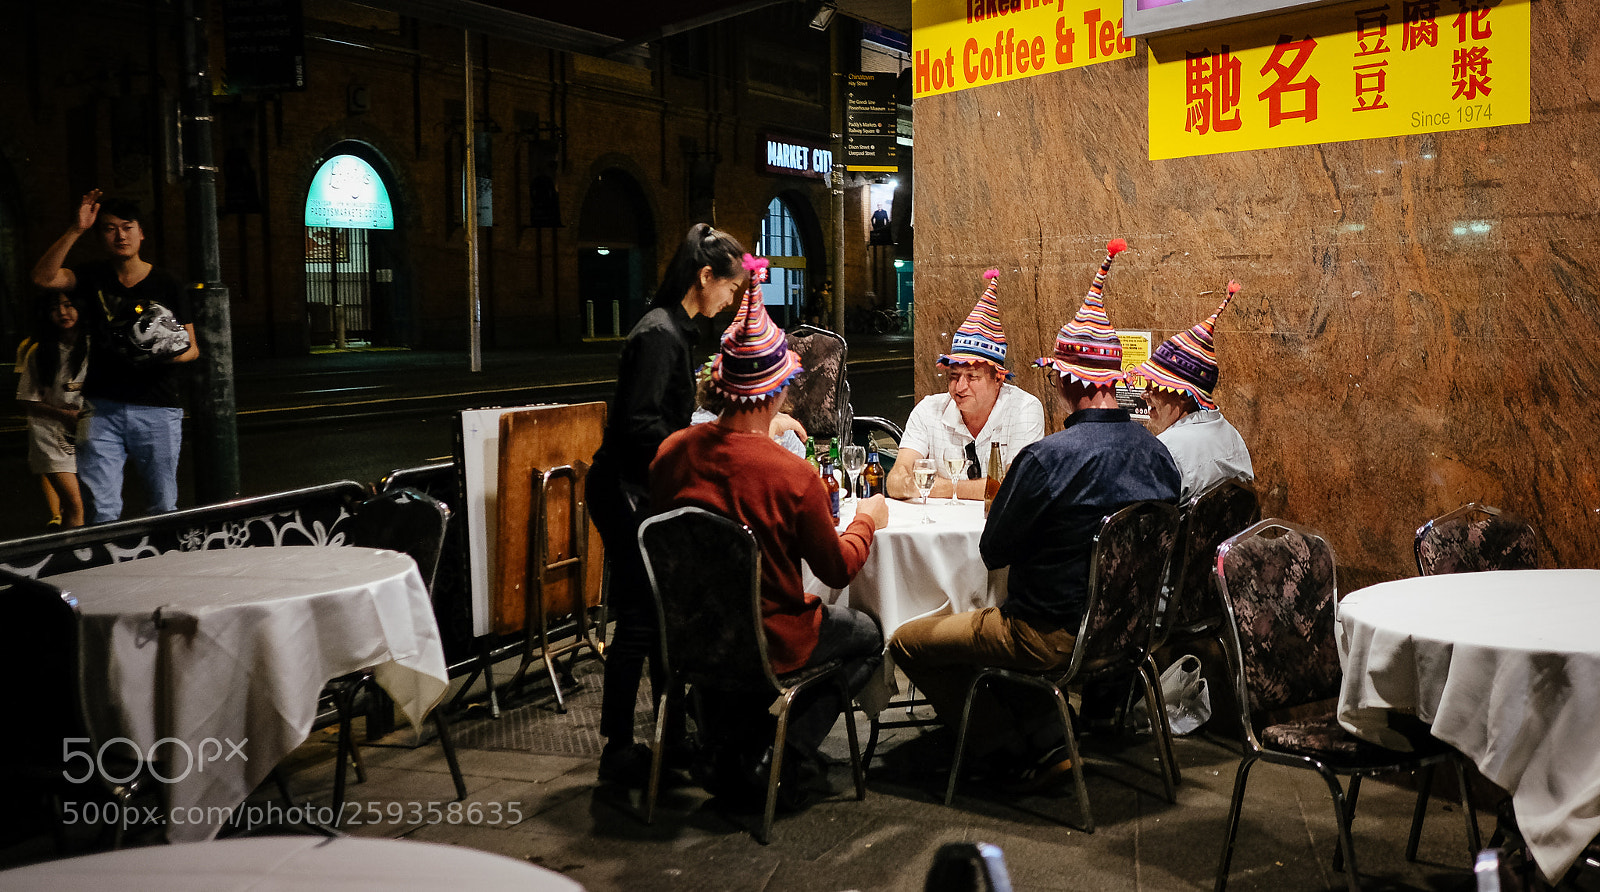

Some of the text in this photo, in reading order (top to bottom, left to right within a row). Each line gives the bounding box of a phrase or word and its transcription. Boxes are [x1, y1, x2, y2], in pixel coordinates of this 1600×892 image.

[967, 0, 1064, 24] Takea
[915, 8, 1132, 94] Hot Coffee & Tea
[848, 73, 875, 81] Chinatown
[1185, 34, 1321, 136] 馳名
[1411, 103, 1493, 128] Since 1974
[767, 140, 809, 170] MARKET
